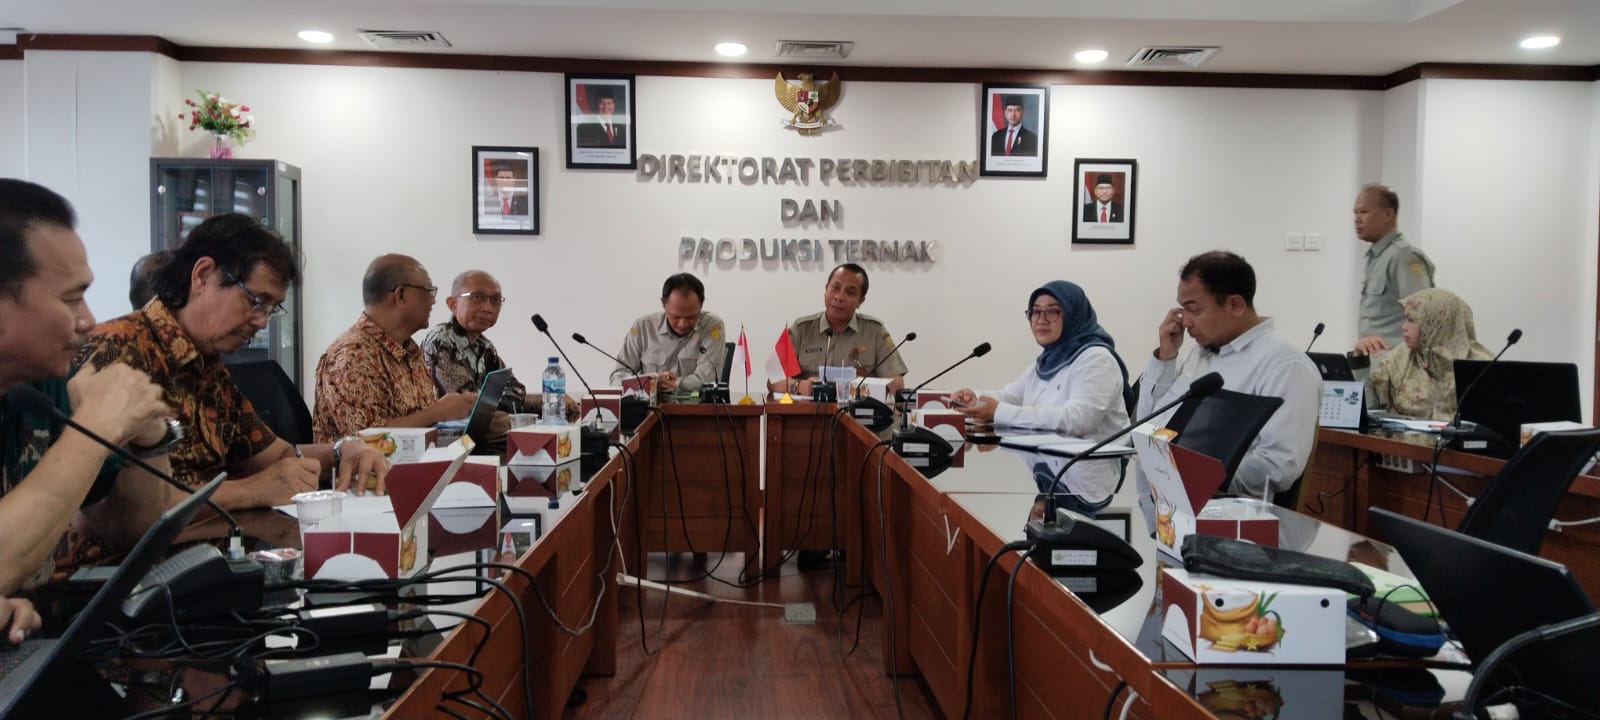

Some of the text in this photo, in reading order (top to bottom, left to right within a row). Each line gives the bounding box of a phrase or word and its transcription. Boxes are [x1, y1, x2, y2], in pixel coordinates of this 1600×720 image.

[638, 153, 979, 186] DIREKTORAT PERBIBITAN
[780, 198, 841, 226] DAN
[679, 236, 938, 267] PRODUKSI TERNAK
